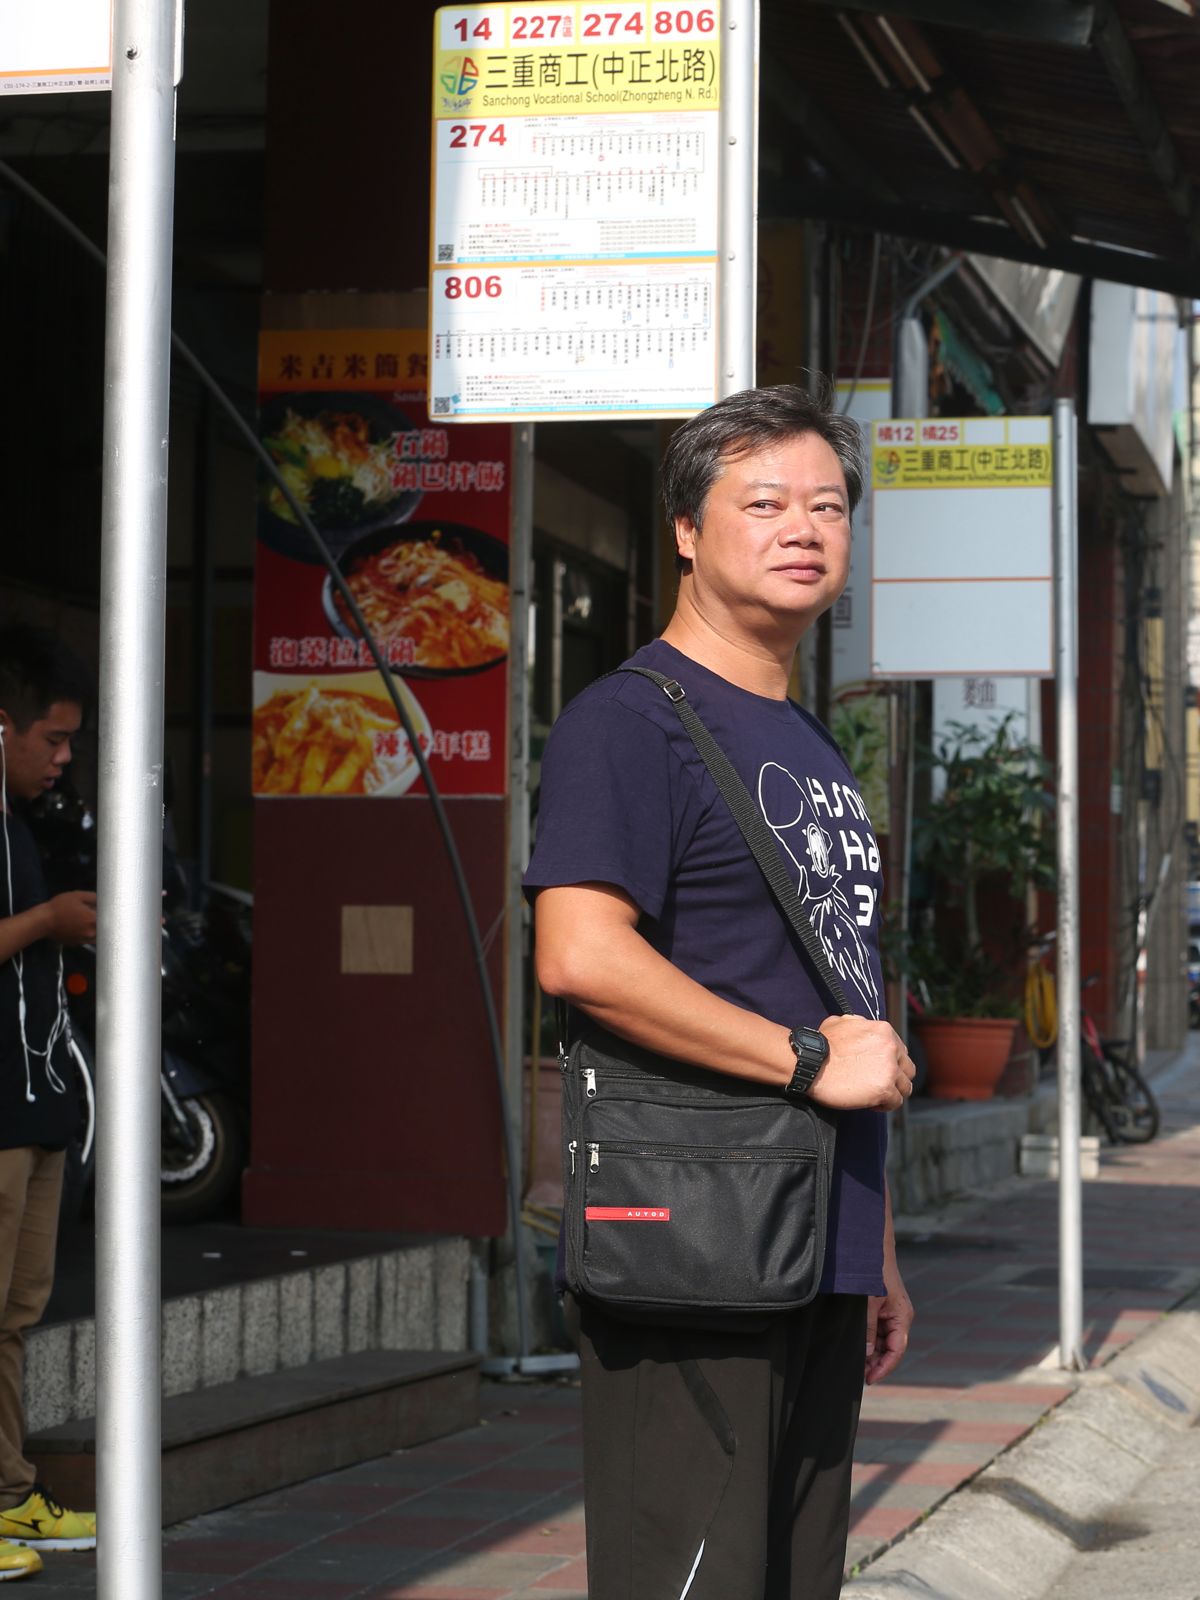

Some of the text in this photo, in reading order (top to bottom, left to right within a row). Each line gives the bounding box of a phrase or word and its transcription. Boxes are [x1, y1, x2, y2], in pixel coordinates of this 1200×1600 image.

[454, 15, 562, 42] 14 227
[583, 9, 715, 36] 274 806
[485, 48, 715, 90] 三重商工(中正北路)
[483, 94, 531, 108] Sanchong
[533, 91, 583, 104] Vocational
[449, 124, 507, 148] 274
[444, 276, 502, 299] 806
